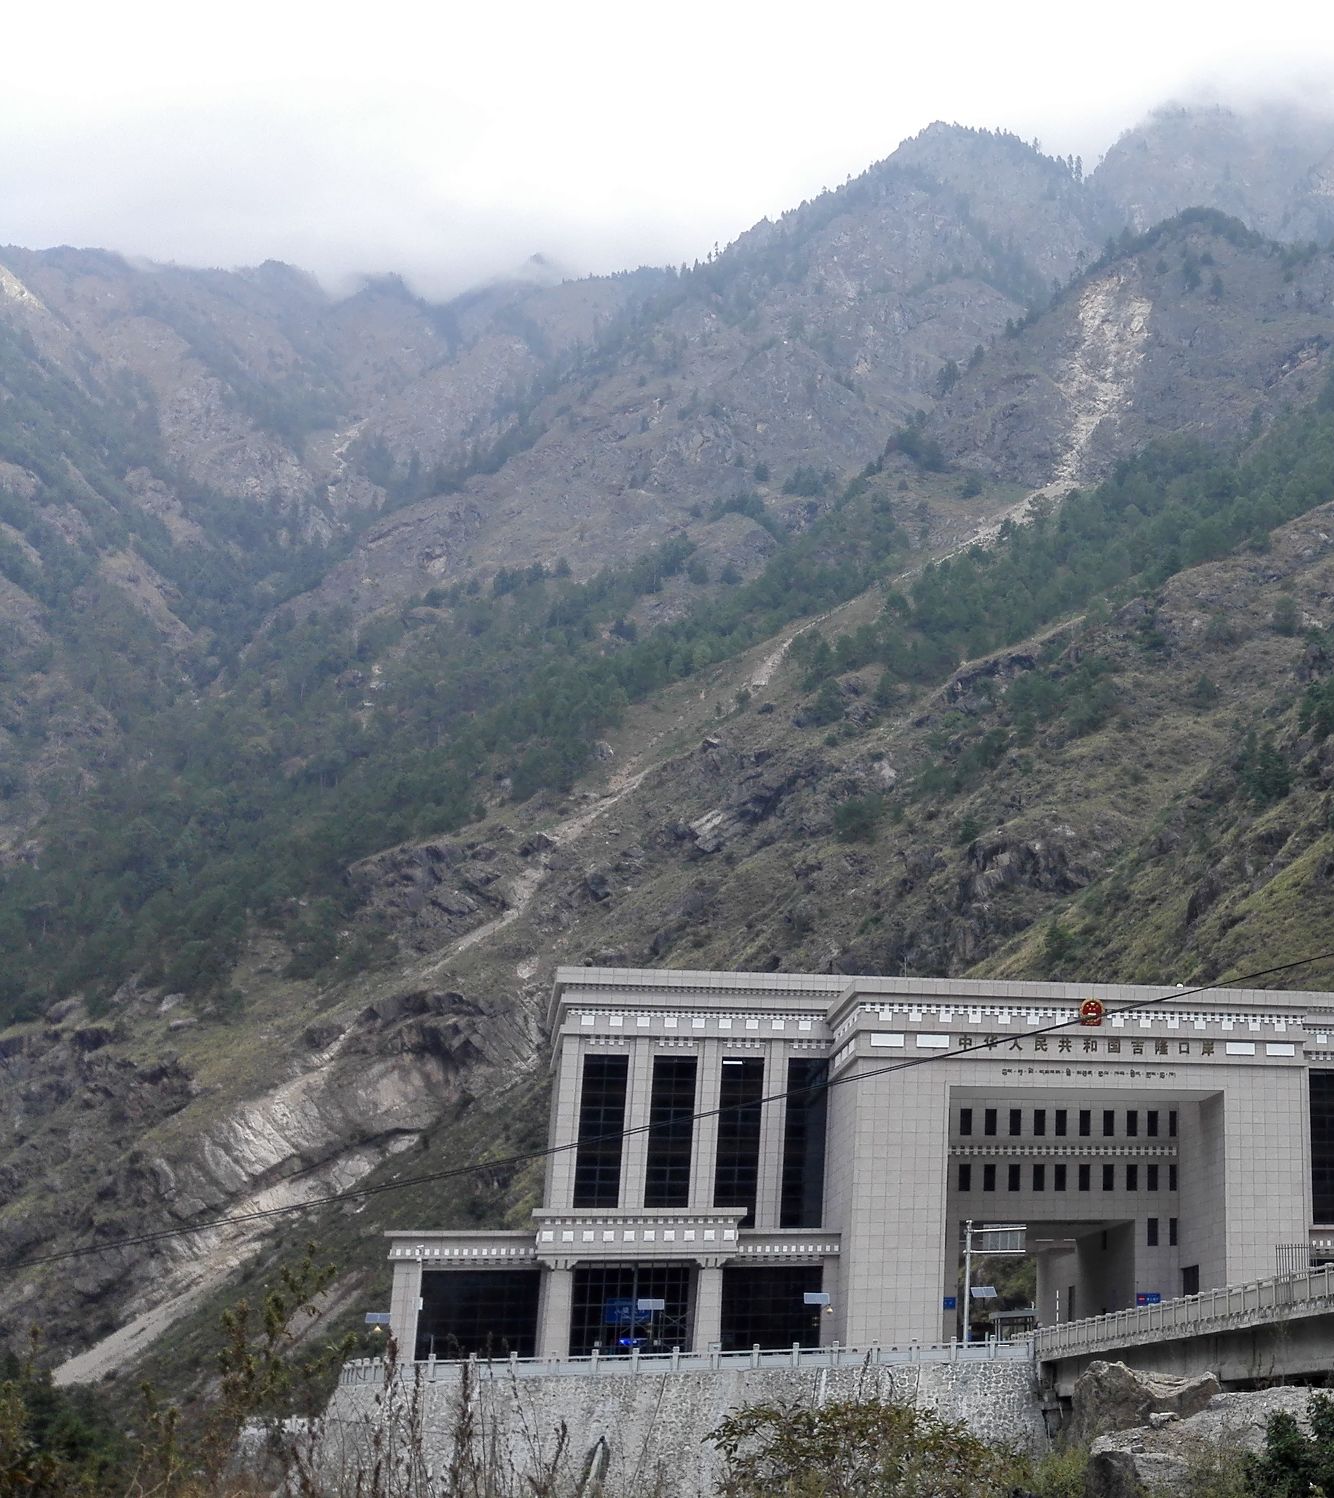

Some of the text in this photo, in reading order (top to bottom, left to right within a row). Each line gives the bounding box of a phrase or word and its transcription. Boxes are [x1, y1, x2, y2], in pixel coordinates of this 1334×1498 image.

[958, 1034, 1215, 1056] 中华人民共和国吉隆口岸
